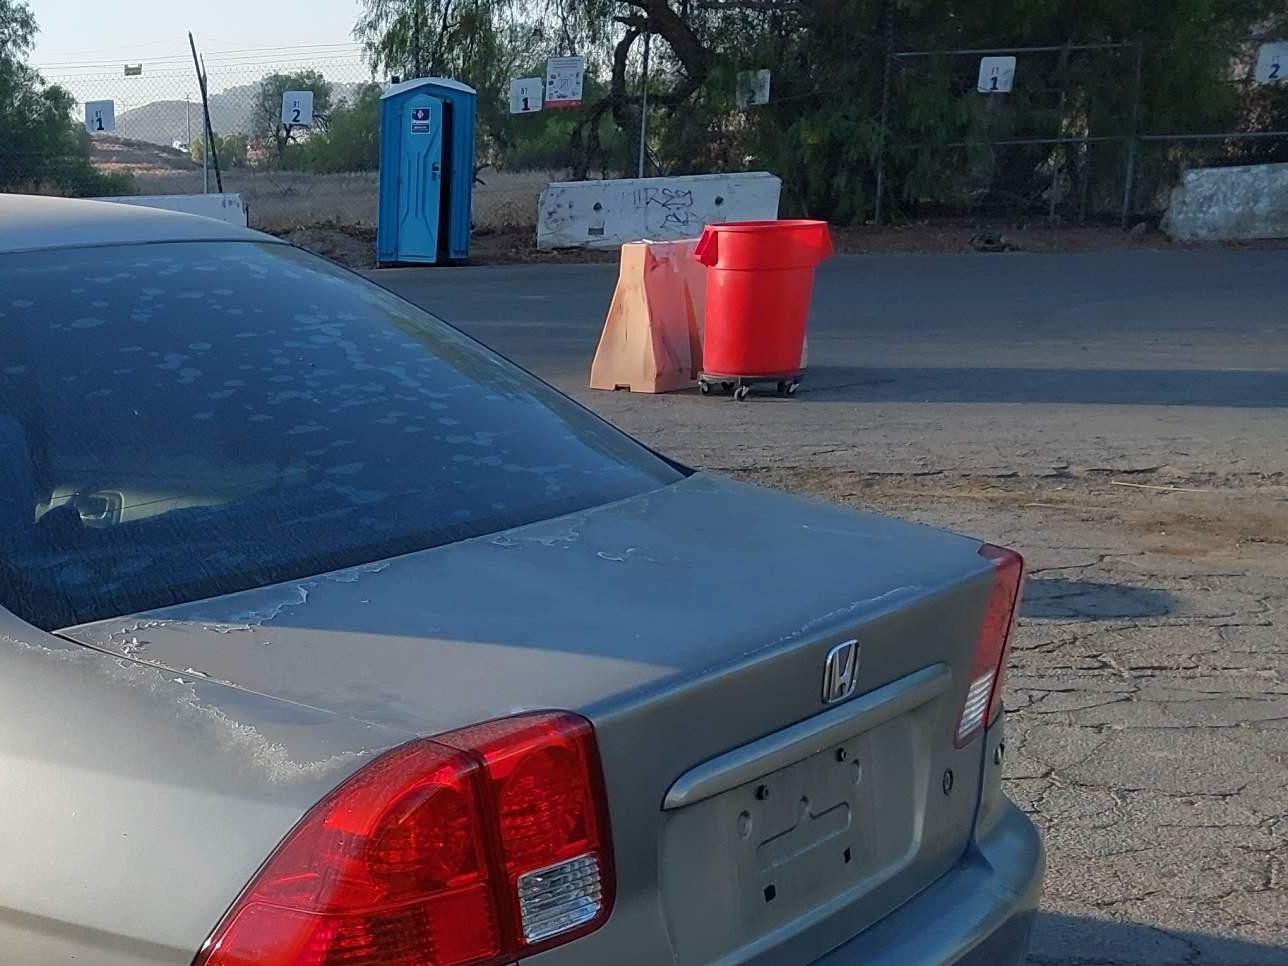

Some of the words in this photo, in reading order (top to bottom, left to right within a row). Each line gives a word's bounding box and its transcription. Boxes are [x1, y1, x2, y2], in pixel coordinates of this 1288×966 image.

[1268, 64, 1280, 79] 2
[990, 77, 999, 90] 1
[521, 97, 530, 111] 1
[292, 109, 301, 122] 2
[96, 118, 105, 130] 1
